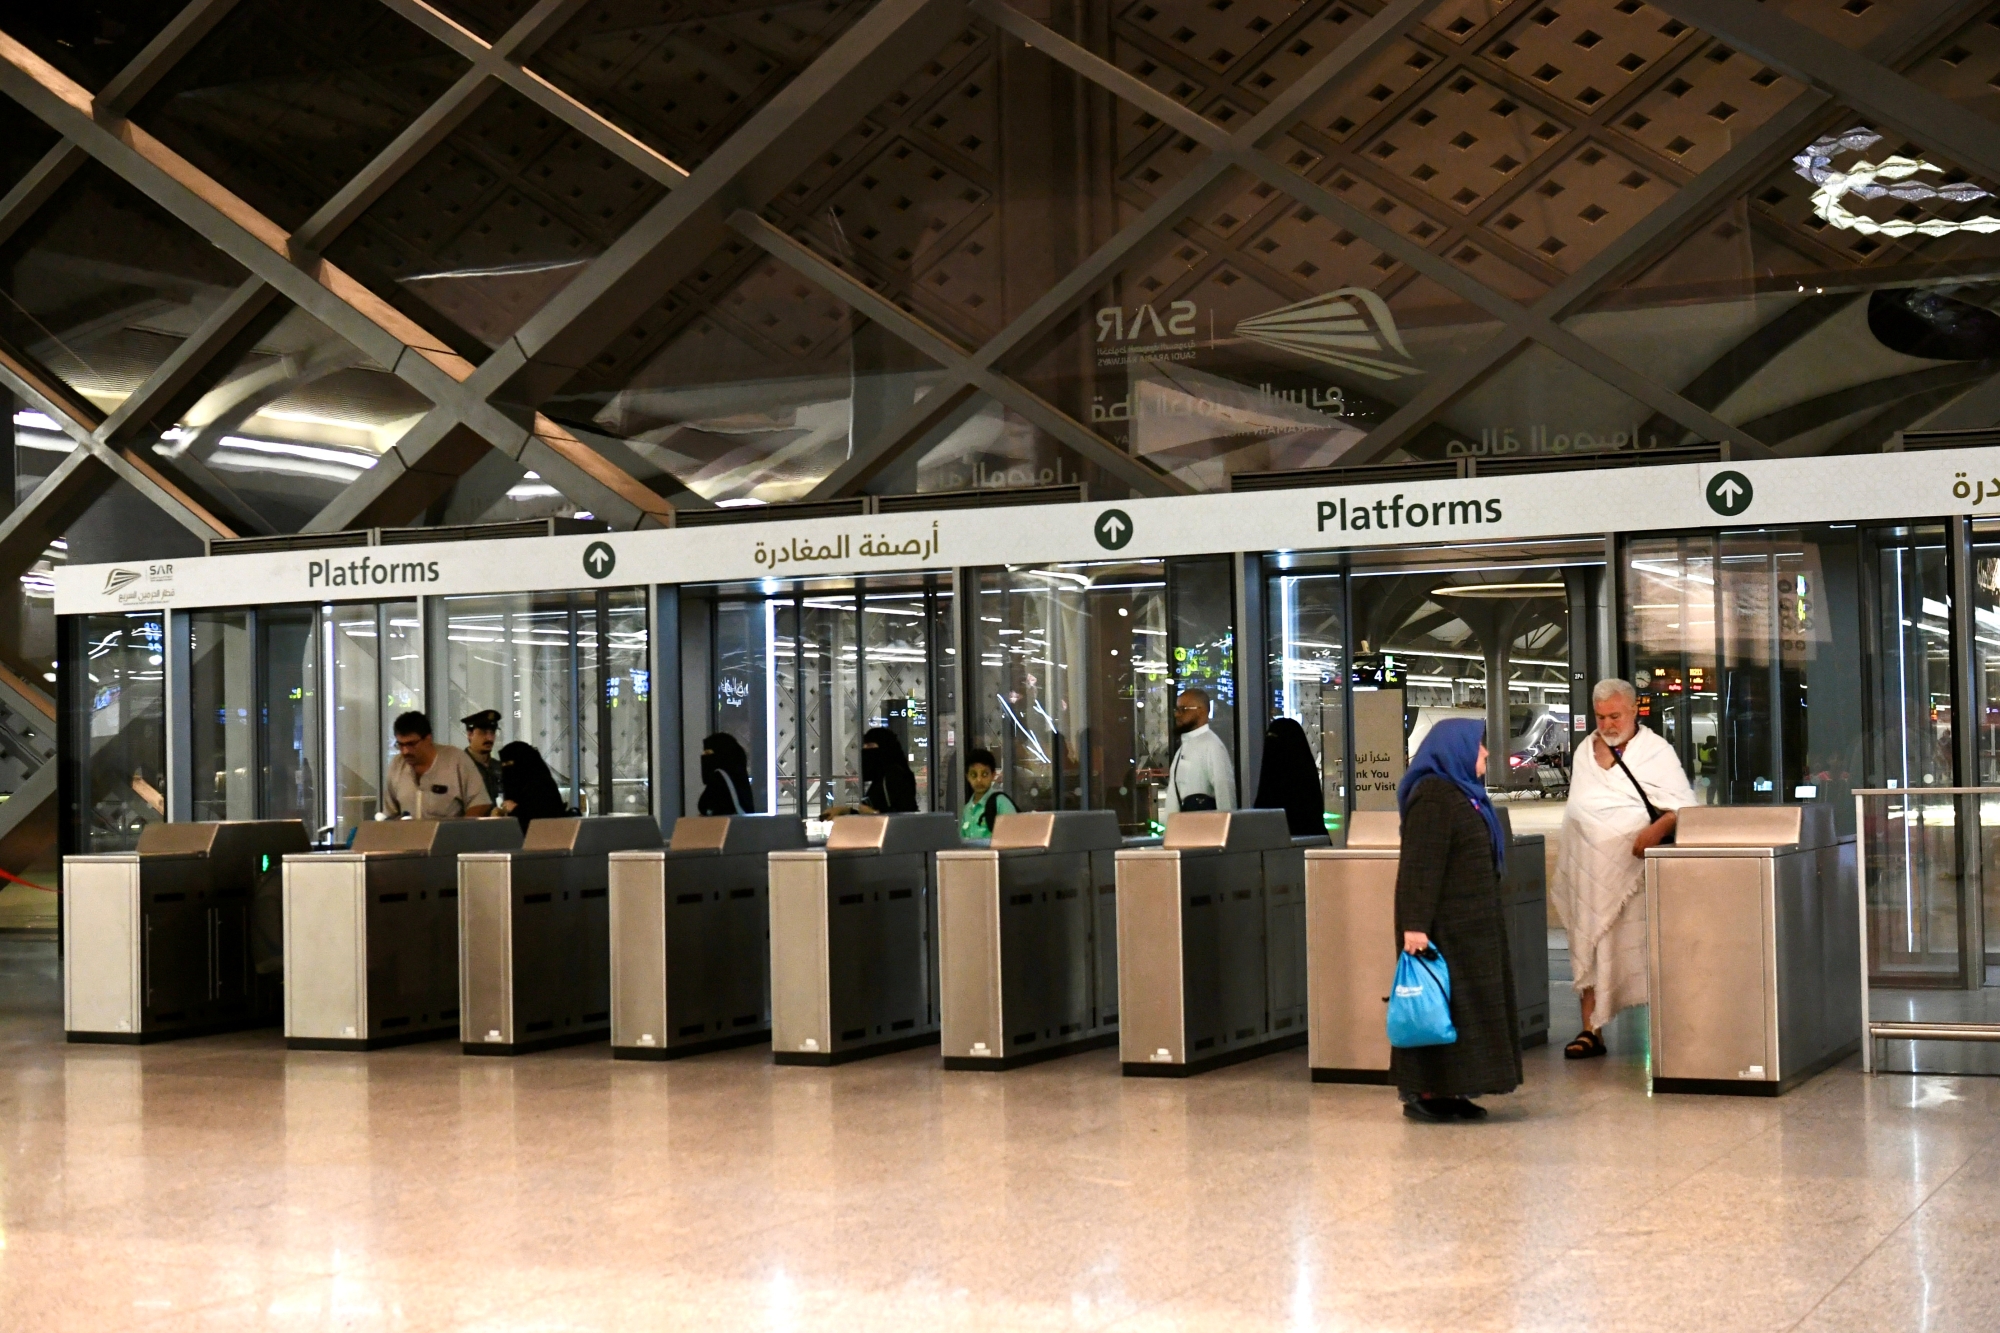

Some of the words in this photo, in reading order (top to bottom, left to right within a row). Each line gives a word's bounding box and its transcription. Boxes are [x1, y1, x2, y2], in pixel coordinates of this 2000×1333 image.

[1317, 494, 1502, 532] Platforms
[859, 520, 939, 561] أرصفة
[754, 534, 850, 569] المغادرة
[149, 564, 173, 576] SAR
[309, 556, 440, 588] Platforms
[1321, 671, 1330, 684] 5
[1374, 669, 1383, 682] 4
[1337, 769, 1368, 779] Tnk
[1370, 769, 1390, 779] You
[1354, 783, 1372, 791] our
[1375, 781, 1397, 791] Visit
